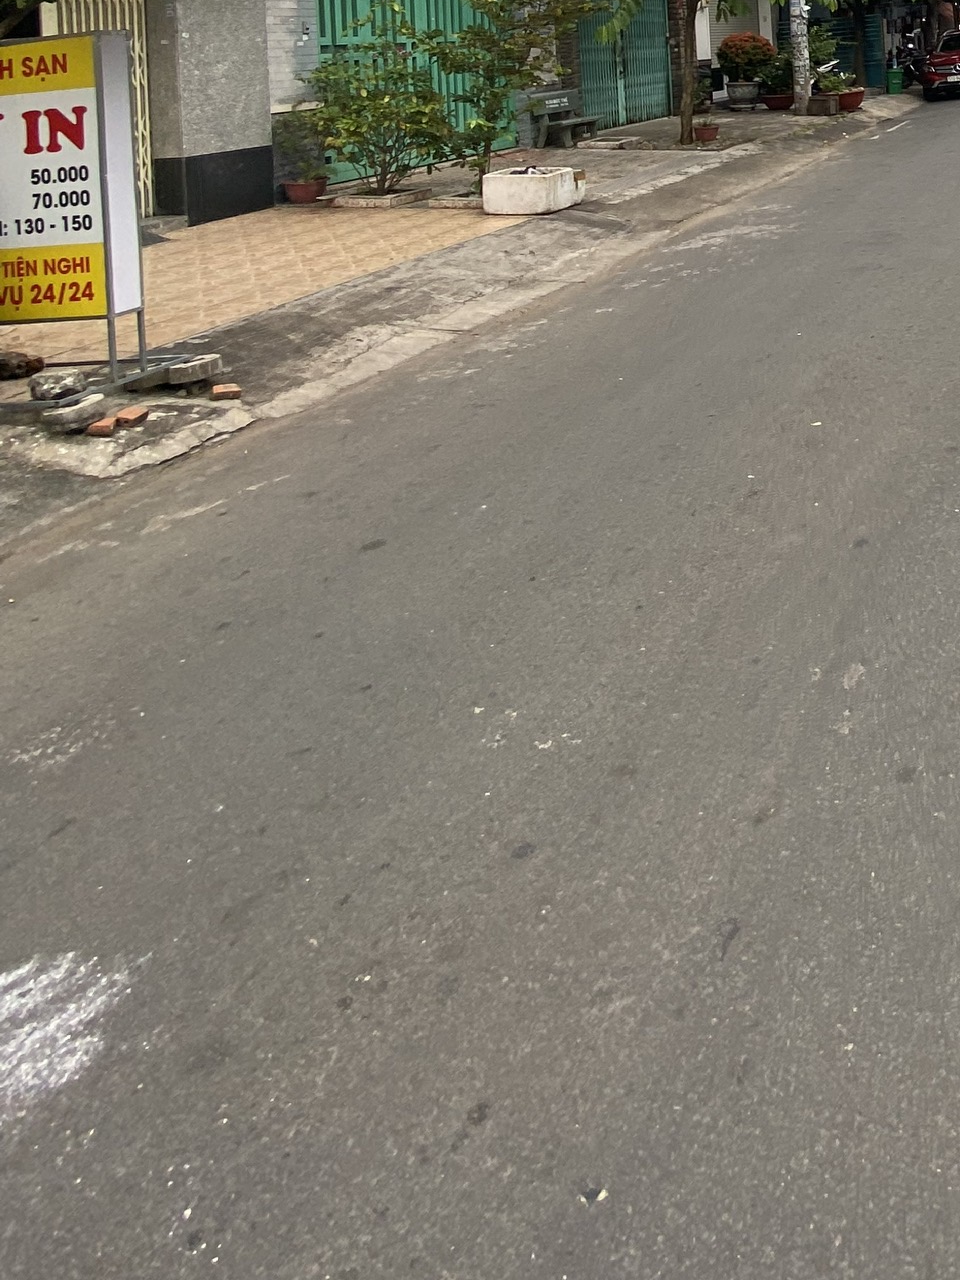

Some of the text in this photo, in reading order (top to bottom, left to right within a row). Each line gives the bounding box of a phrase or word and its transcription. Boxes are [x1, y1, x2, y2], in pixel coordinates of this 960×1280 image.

[21, 52, 68, 83] SẠN
[21, 105, 88, 155] IN
[30, 165, 89, 186] 50.000
[32, 190, 91, 210] 70.000
[14, 217, 45, 236] 130
[61, 214, 93, 232] 150
[1, 256, 91, 283] TIỆN NGHI
[30, 281, 95, 305] 24/24
